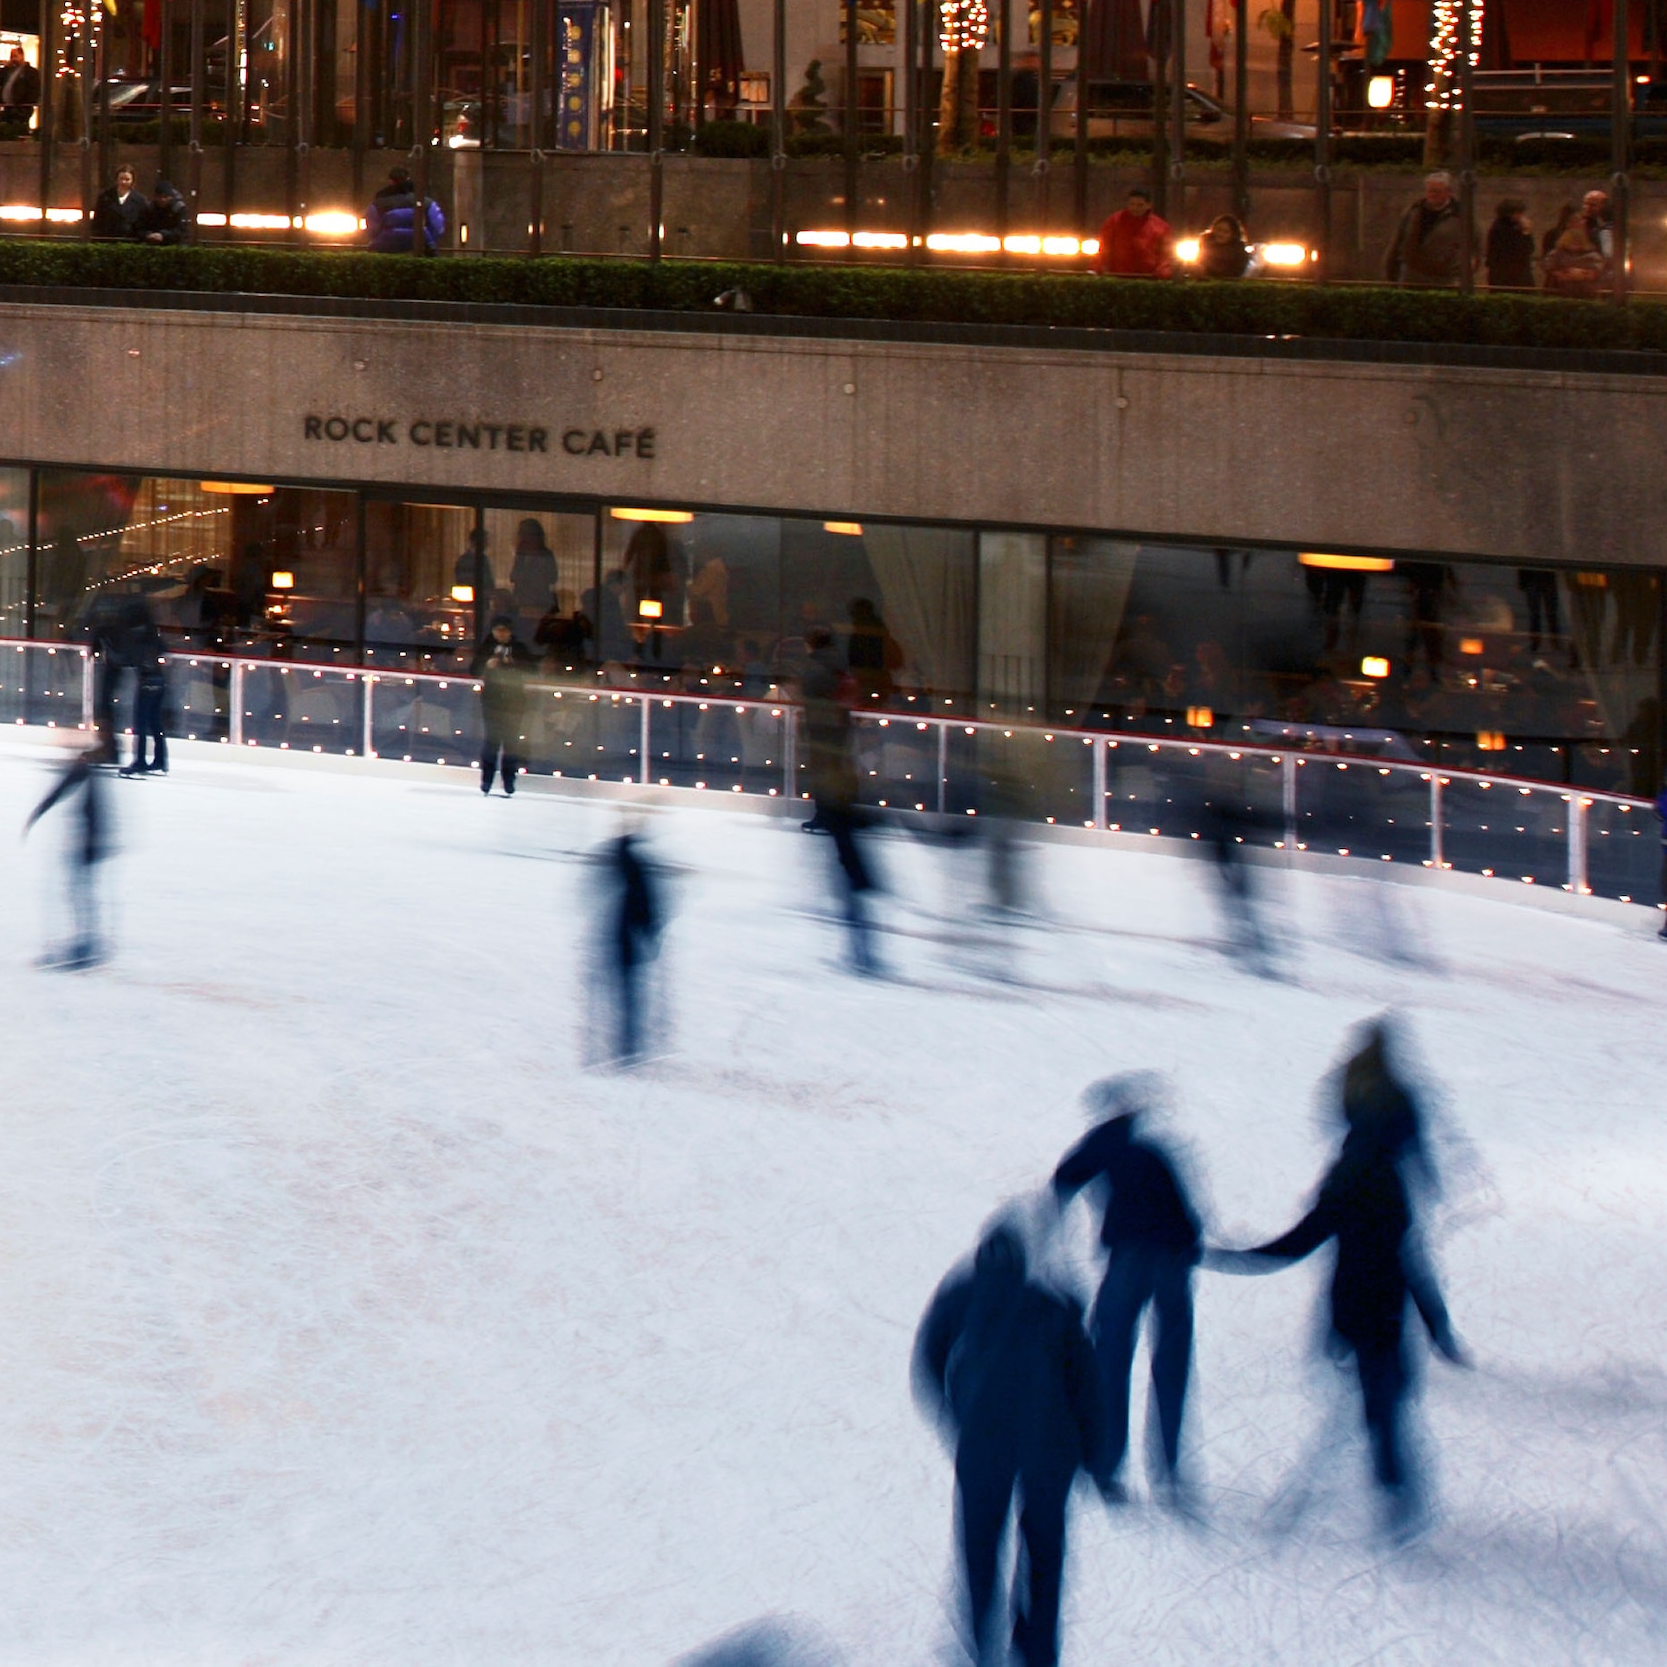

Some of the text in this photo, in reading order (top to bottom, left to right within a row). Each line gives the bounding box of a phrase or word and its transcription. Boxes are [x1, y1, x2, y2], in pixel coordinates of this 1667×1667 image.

[304, 416, 656, 459] ROCK CENTER CAFÉ
